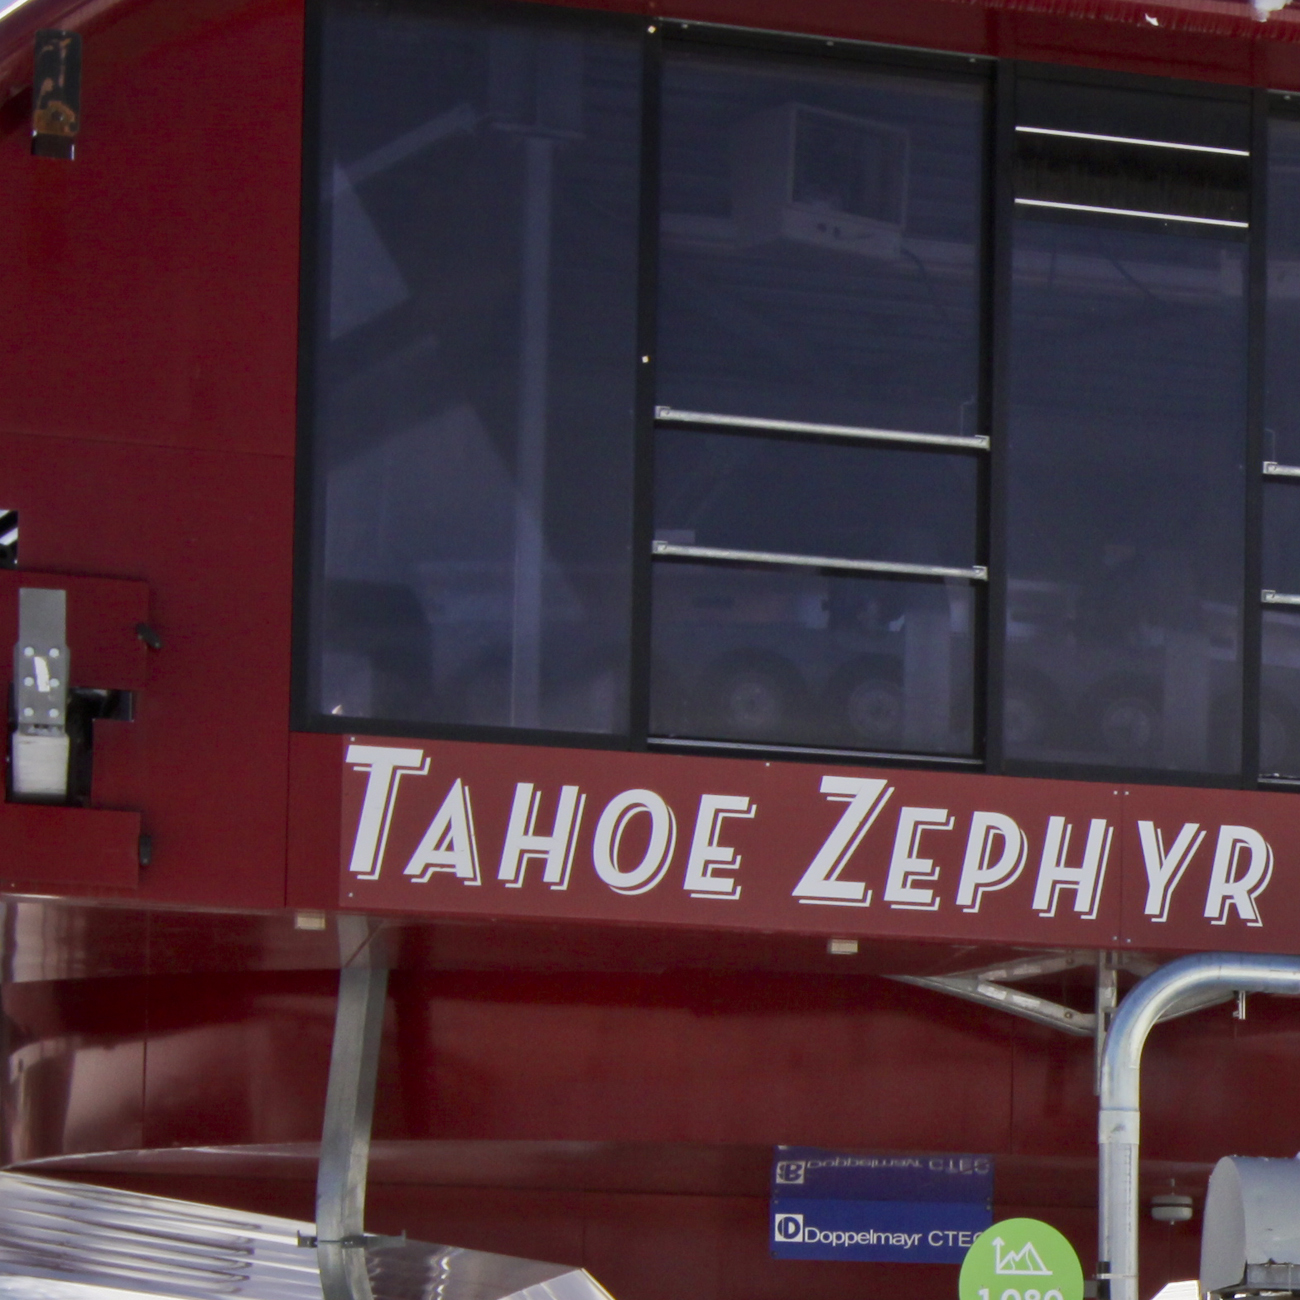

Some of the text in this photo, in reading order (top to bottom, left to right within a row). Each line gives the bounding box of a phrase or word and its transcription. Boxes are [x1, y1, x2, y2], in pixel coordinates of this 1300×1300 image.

[345, 744, 757, 899] TAHOE
[791, 775, 1273, 927] ZEPHYR
[804, 1227, 922, 1249] Doppelmayr
